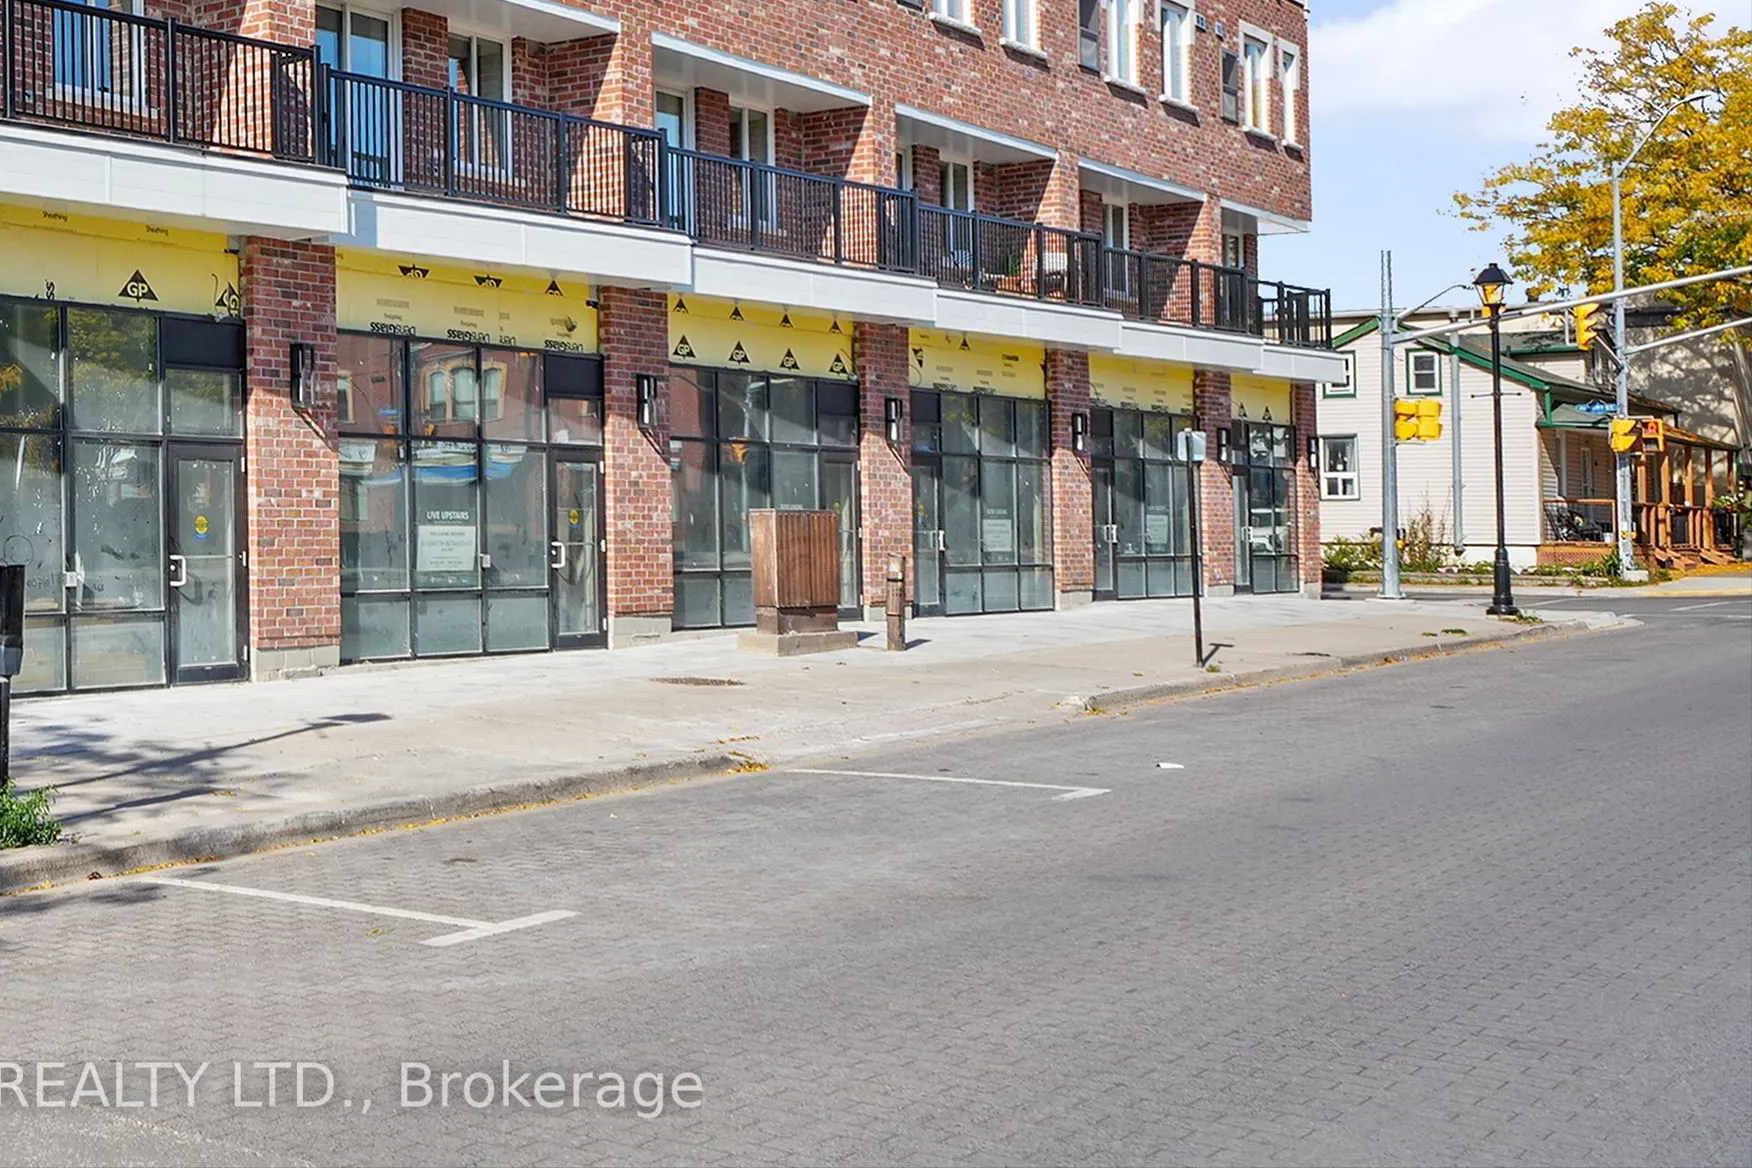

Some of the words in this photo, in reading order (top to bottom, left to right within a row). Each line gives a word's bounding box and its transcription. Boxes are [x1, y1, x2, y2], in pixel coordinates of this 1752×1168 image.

[42, 210, 68, 222] Sheathing
[127, 282, 148, 298] GP
[677, 343, 690, 354] GP
[733, 350, 745, 361] GP
[784, 357, 795, 367] GP
[833, 362, 843, 372] GP
